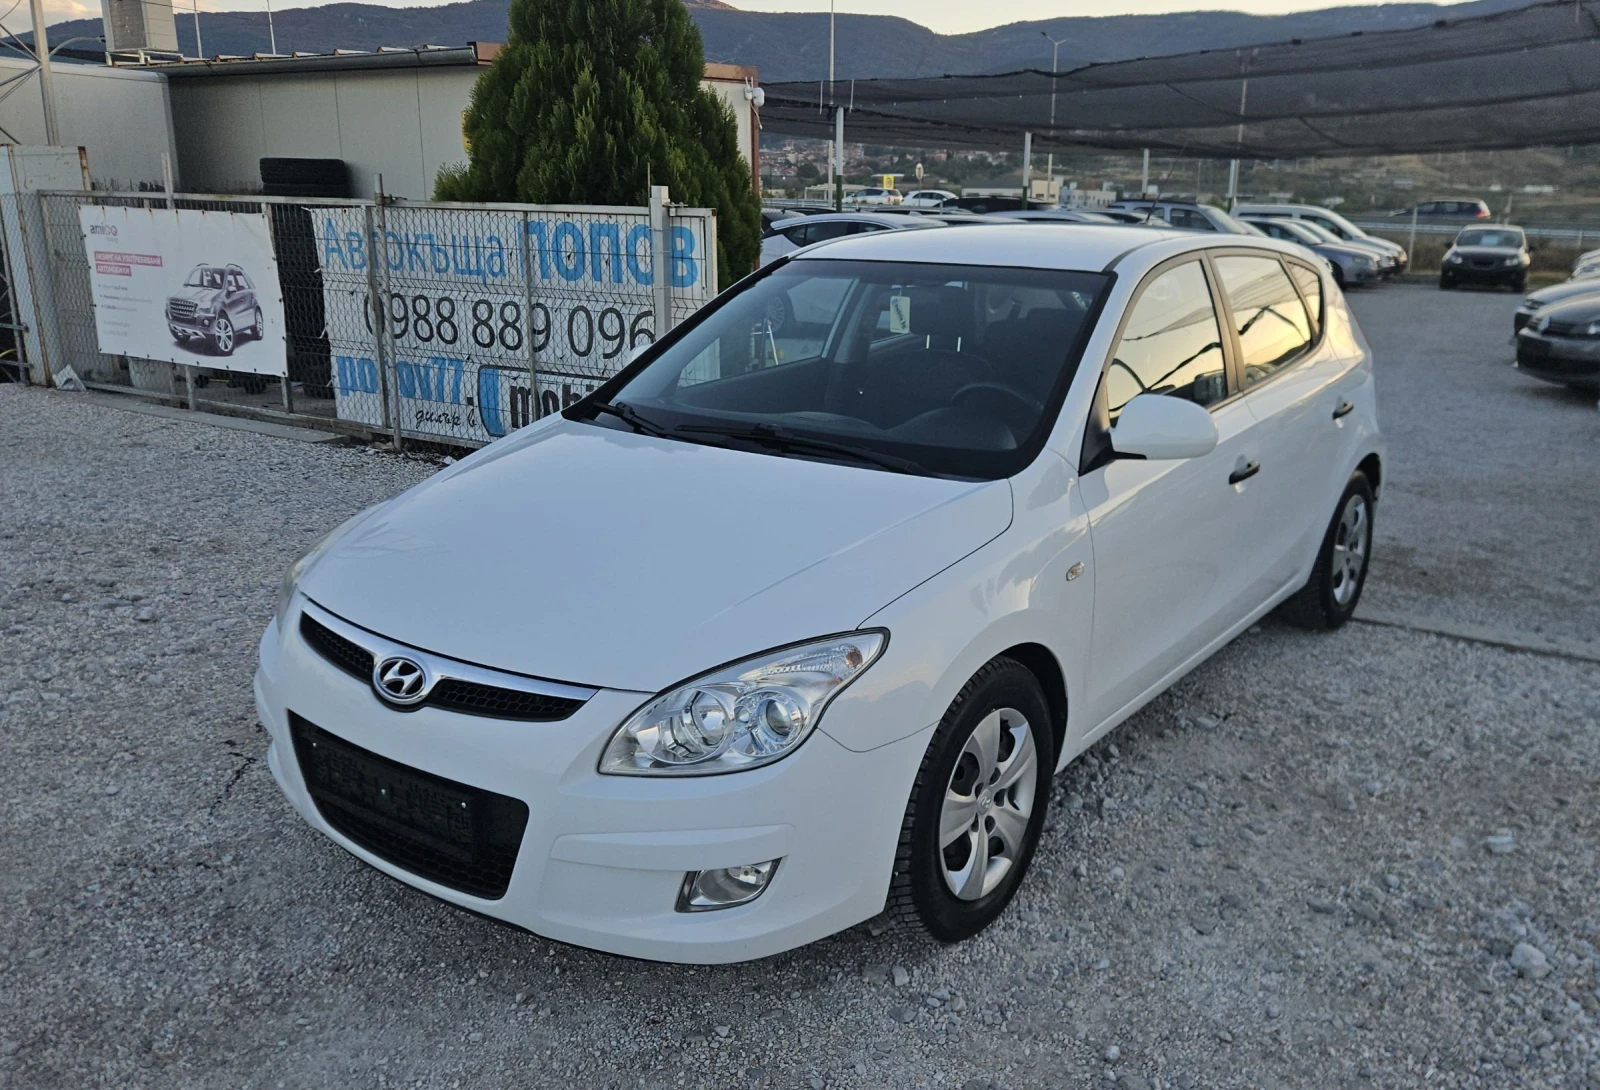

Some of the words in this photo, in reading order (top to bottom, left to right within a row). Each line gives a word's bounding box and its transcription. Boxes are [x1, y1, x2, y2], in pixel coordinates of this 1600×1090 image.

[517, 221, 698, 288] ПОПОВ
[364, 293, 459, 345] 0988
[472, 299, 550, 352] 889
[567, 305, 656, 359] 096
